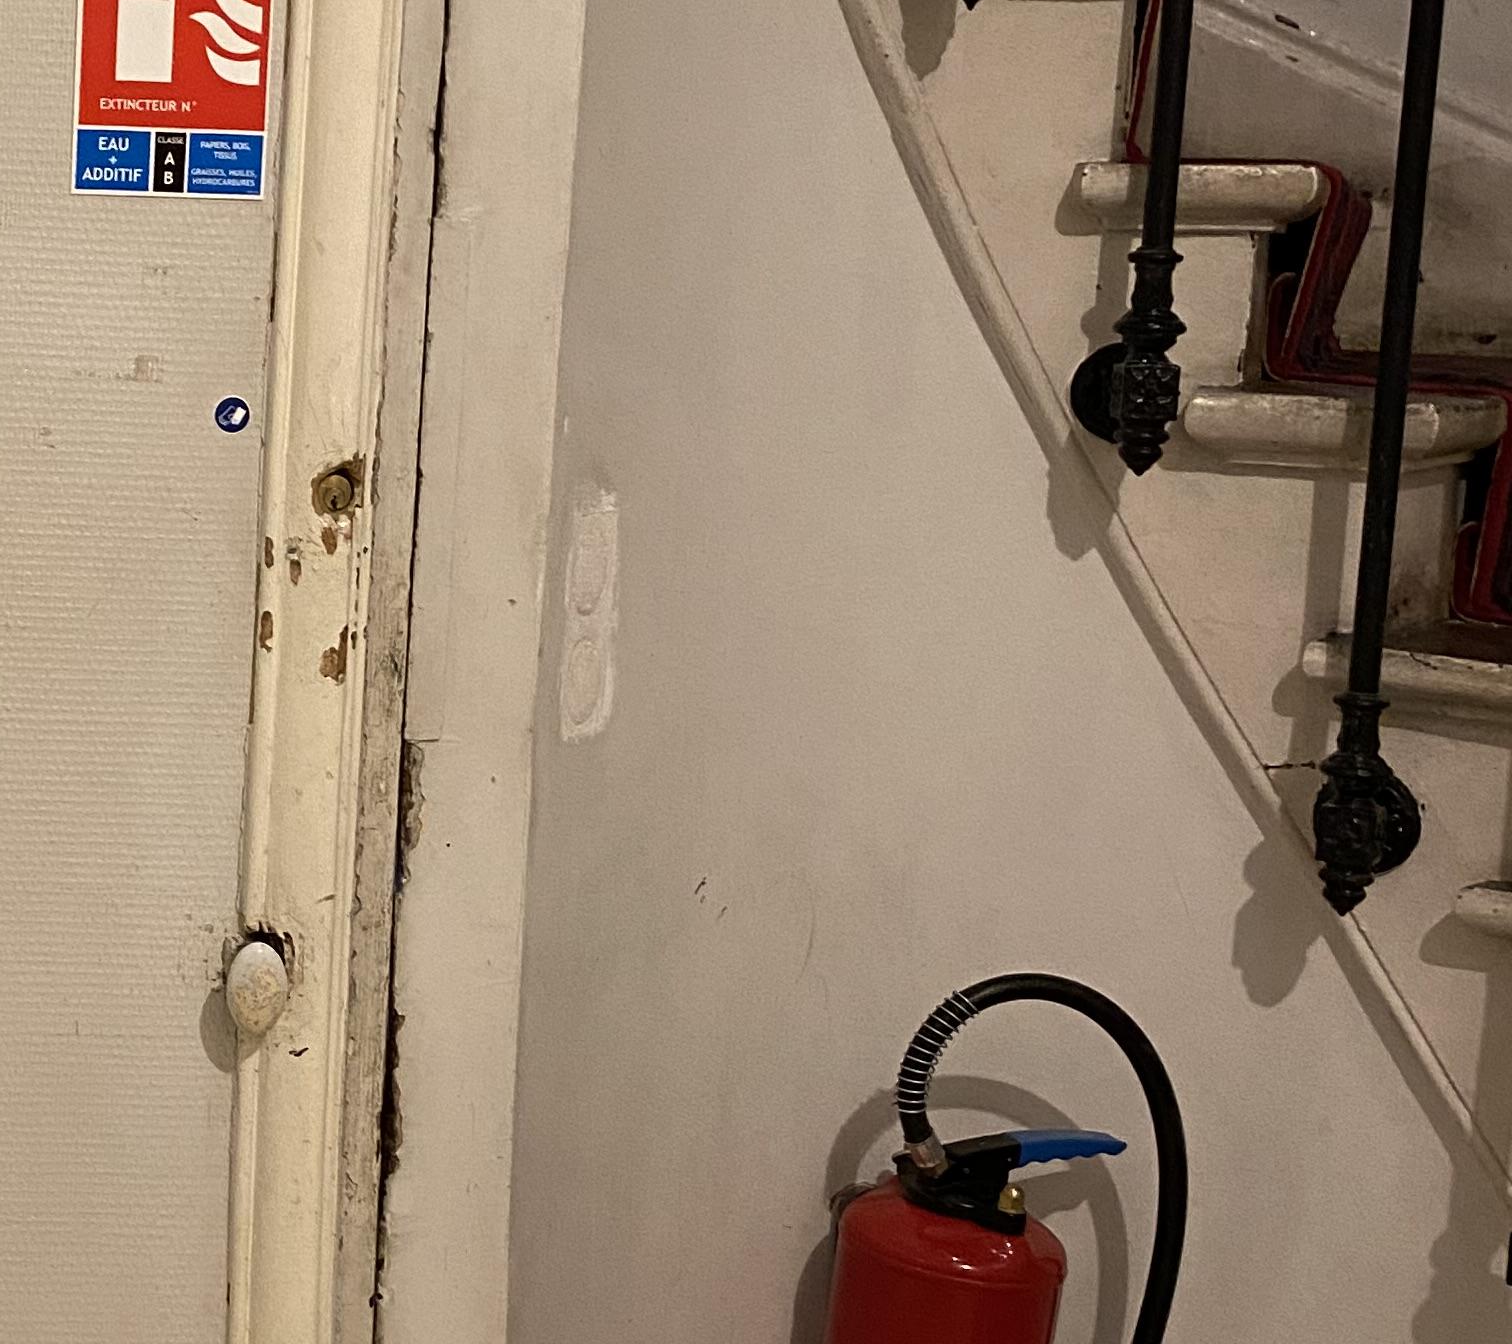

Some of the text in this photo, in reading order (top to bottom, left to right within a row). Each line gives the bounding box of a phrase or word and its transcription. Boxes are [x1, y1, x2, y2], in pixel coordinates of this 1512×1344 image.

[99, 97, 177, 112] EXTINCTEUR
[98, 136, 130, 151] EAU
[157, 136, 185, 145] CLASSE
[164, 151, 175, 165] A
[81, 167, 144, 183] ADDITIF
[163, 170, 174, 185] B
